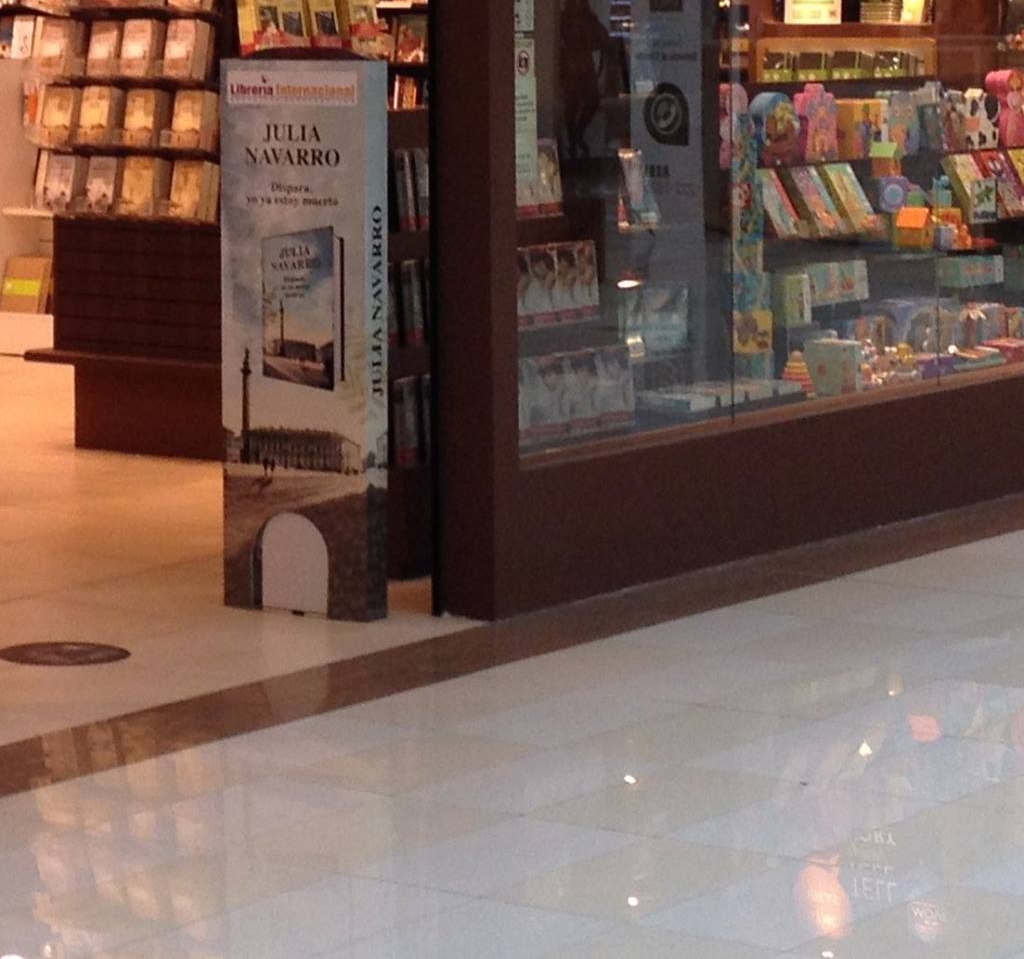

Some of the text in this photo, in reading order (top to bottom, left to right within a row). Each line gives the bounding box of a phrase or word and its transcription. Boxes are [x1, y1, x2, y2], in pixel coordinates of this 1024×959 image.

[263, 124, 321, 142] JULIA
[245, 147, 340, 167] NAVARRO
[372, 206, 384, 397] JULIA NAVARRO
